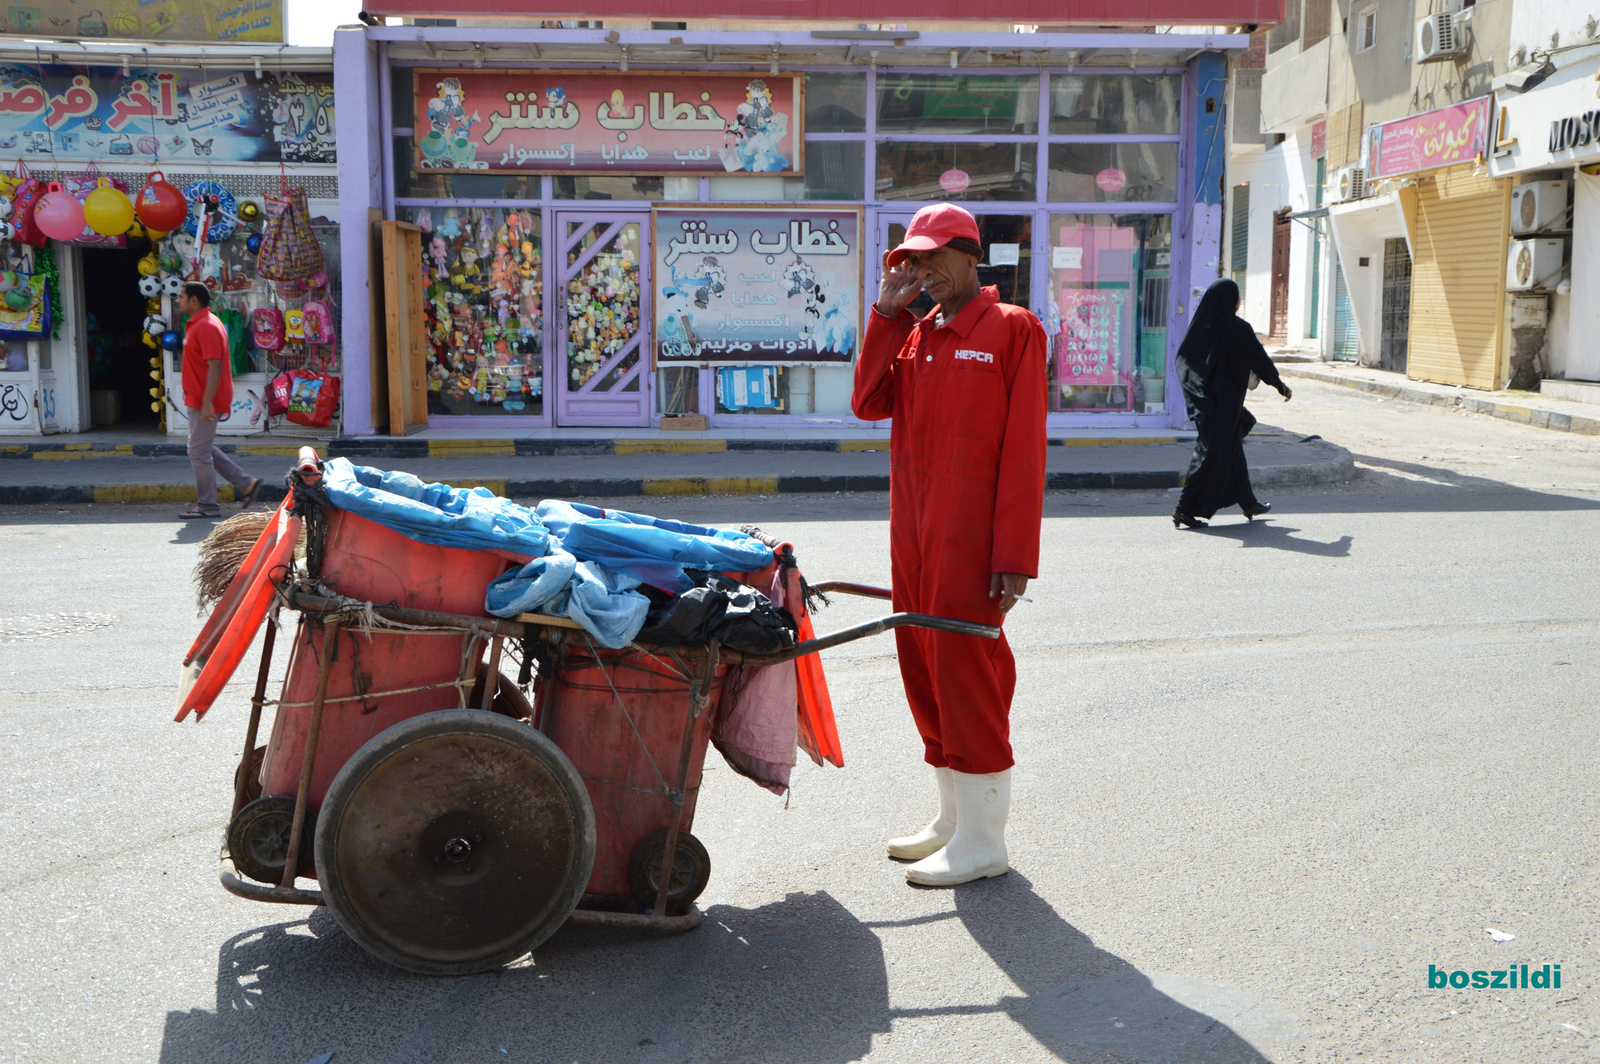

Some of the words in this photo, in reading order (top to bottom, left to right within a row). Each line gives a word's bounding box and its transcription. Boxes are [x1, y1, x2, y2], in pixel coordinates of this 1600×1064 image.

[0, 76, 97, 131] فرص
[107, 72, 177, 130] آخر
[191, 98, 220, 116] أطفال
[222, 93, 239, 106] لعب
[482, 90, 580, 145] سنتر
[597, 90, 726, 142] خطاب
[499, 142, 576, 167] إكسسوار
[600, 143, 649, 165] هدايا
[673, 143, 711, 166] لعب
[663, 219, 739, 267] سنتر
[750, 219, 850, 265] خطاب
[738, 269, 777, 283] لعب
[730, 292, 779, 309] هدايا
[716, 314, 791, 333] إكسسوار
[701, 337, 752, 354] منزلية
[954, 349, 994, 364] HEPCA
